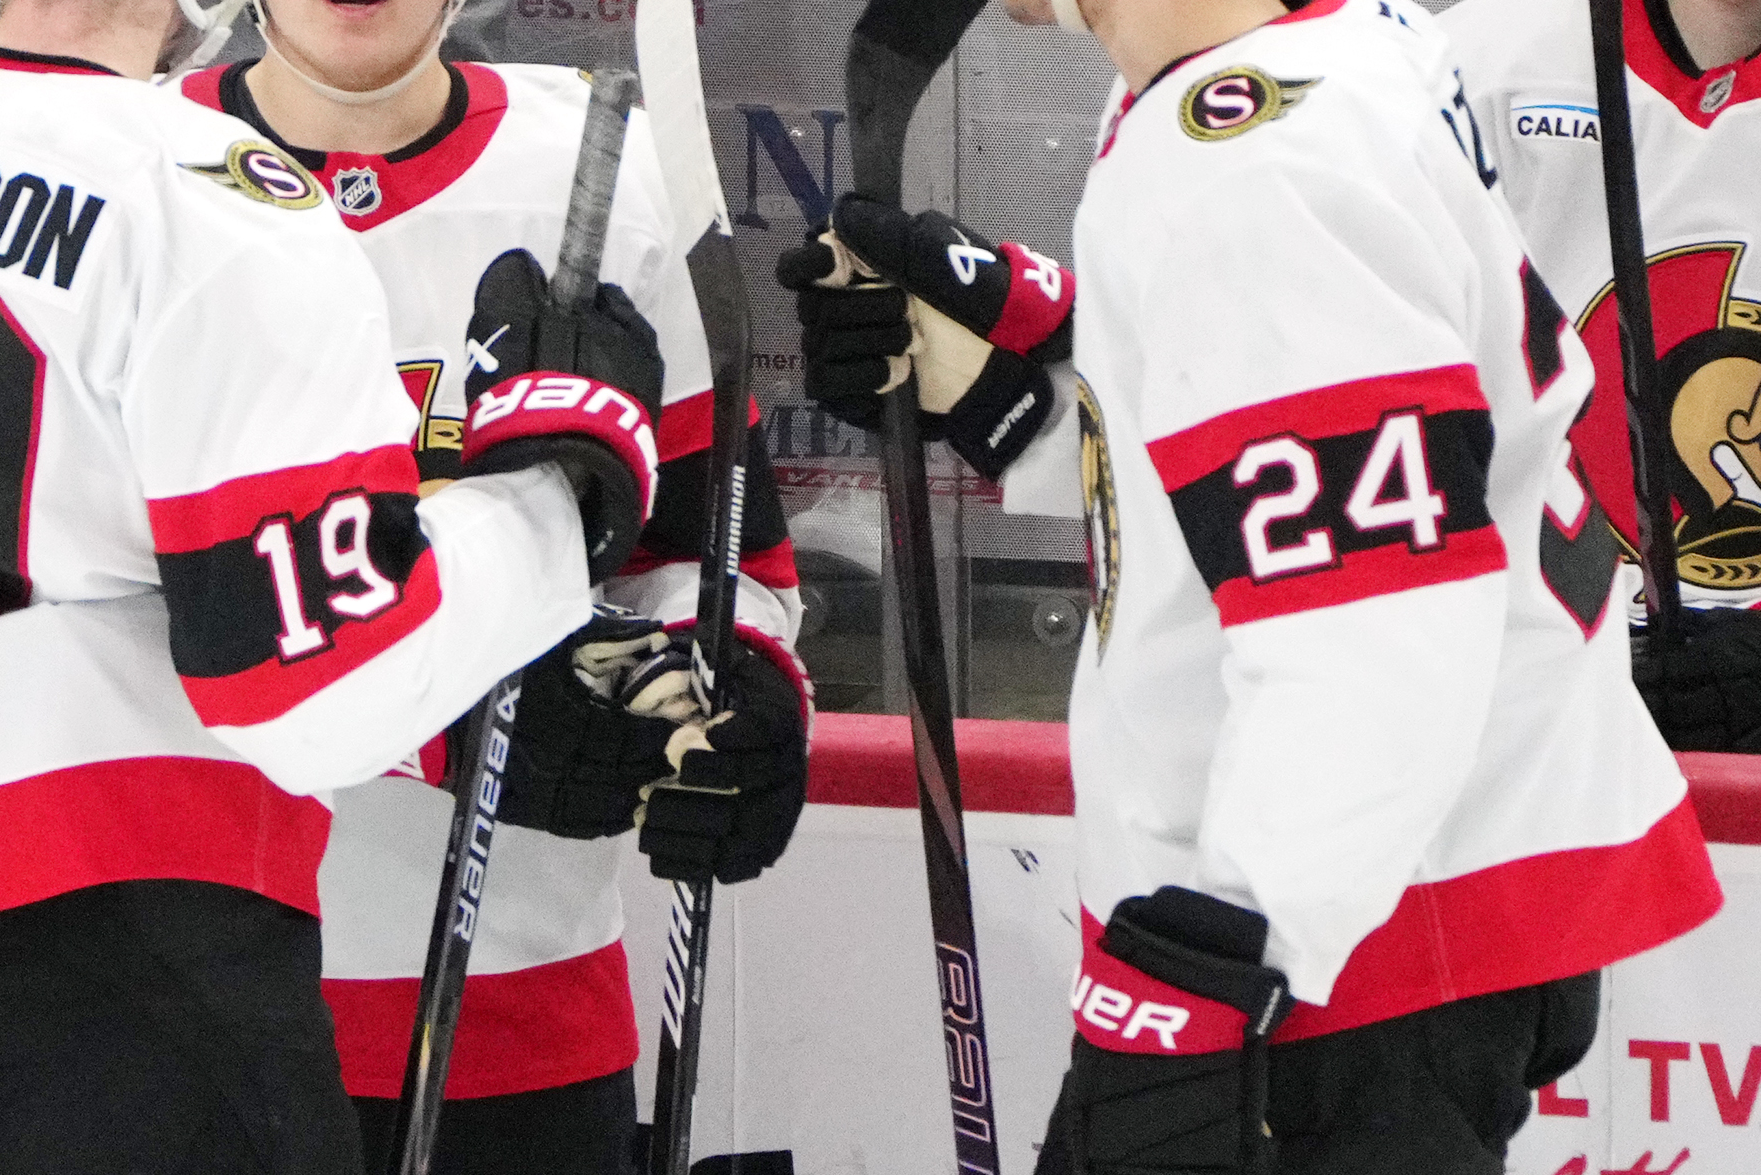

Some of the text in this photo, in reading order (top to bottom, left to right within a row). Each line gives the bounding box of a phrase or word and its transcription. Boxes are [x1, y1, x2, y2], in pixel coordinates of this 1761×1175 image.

[1516, 115, 1602, 142] CALIA
[344, 177, 372, 207] NHL
[1228, 404, 1448, 588] 24
[251, 486, 403, 668] 19
